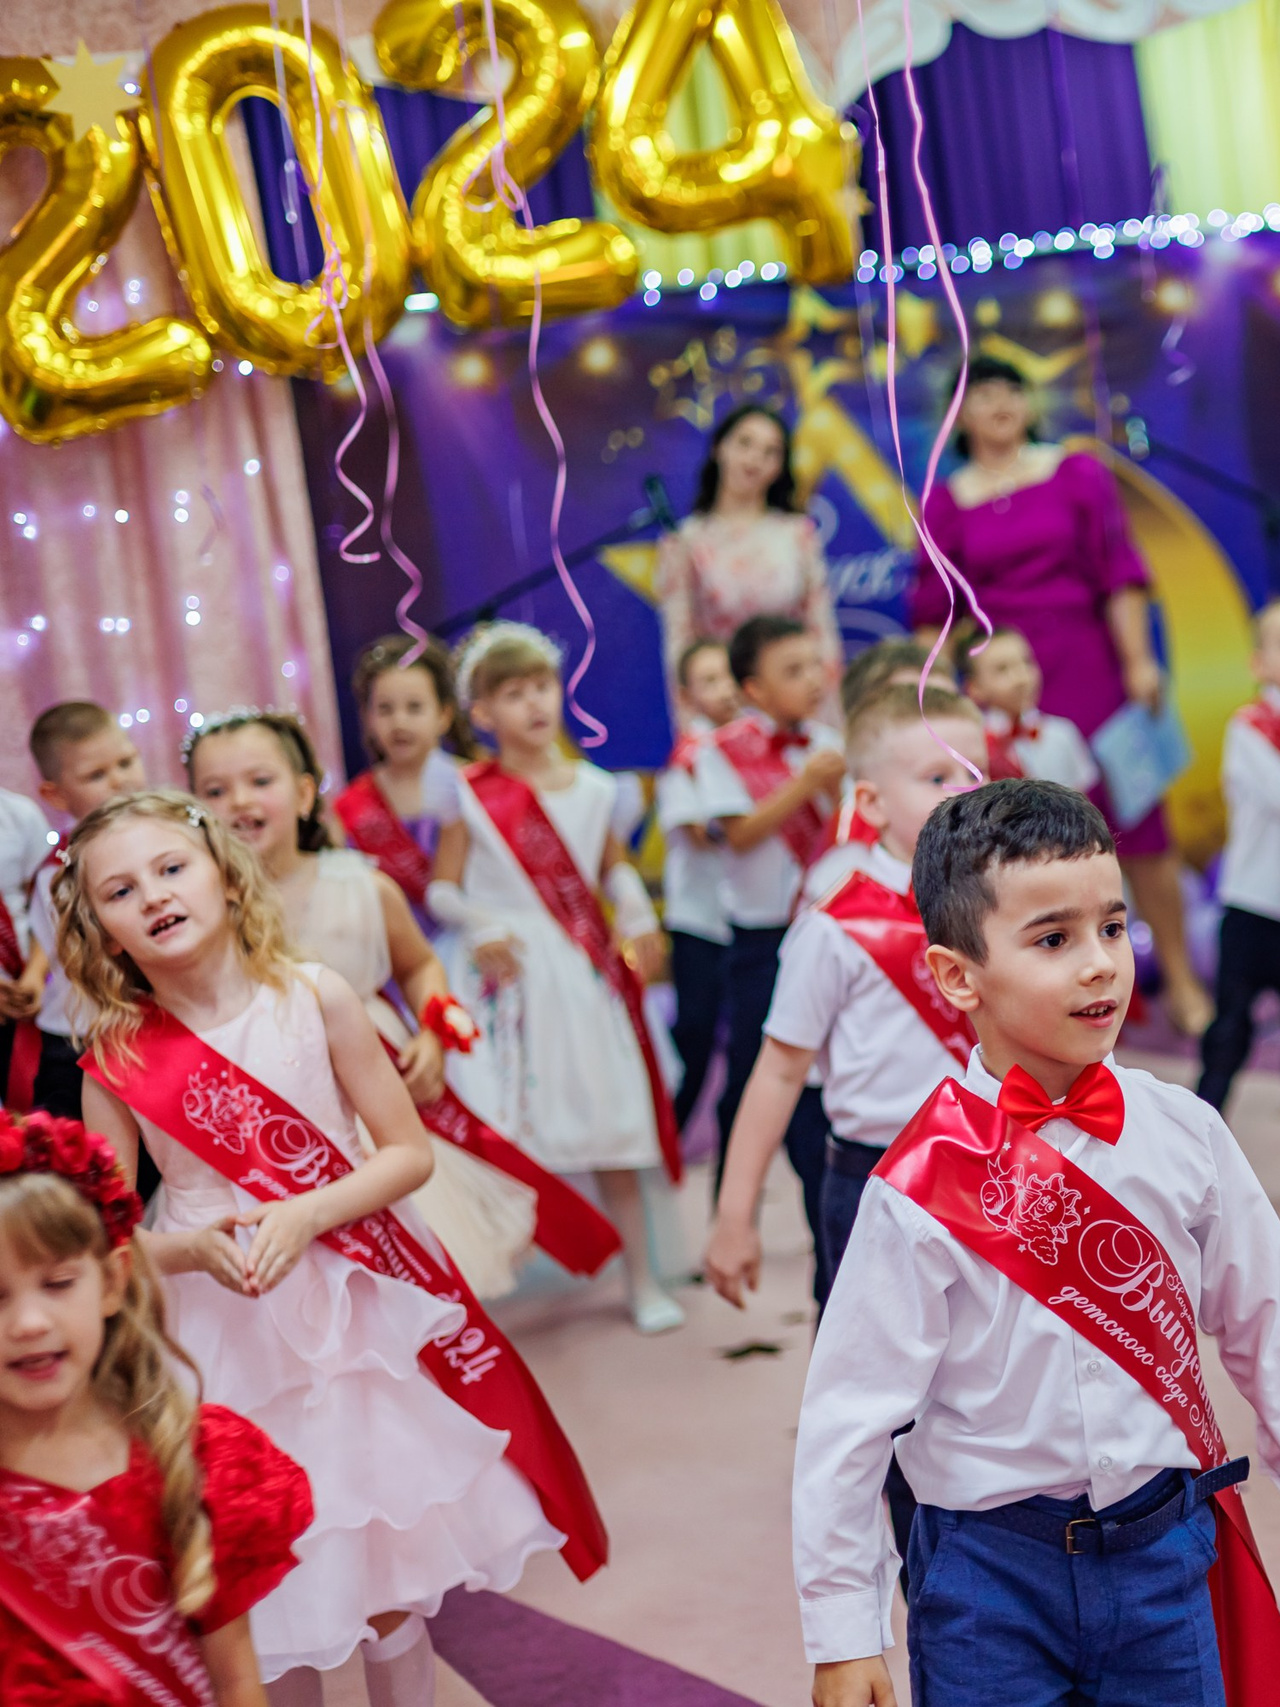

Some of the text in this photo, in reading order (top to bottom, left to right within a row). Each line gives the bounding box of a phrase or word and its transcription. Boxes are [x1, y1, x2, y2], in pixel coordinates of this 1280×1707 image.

[0, 0, 862, 446] 2024
[1048, 1283, 1154, 1367] детского
[1155, 1365, 1188, 1409] сада
